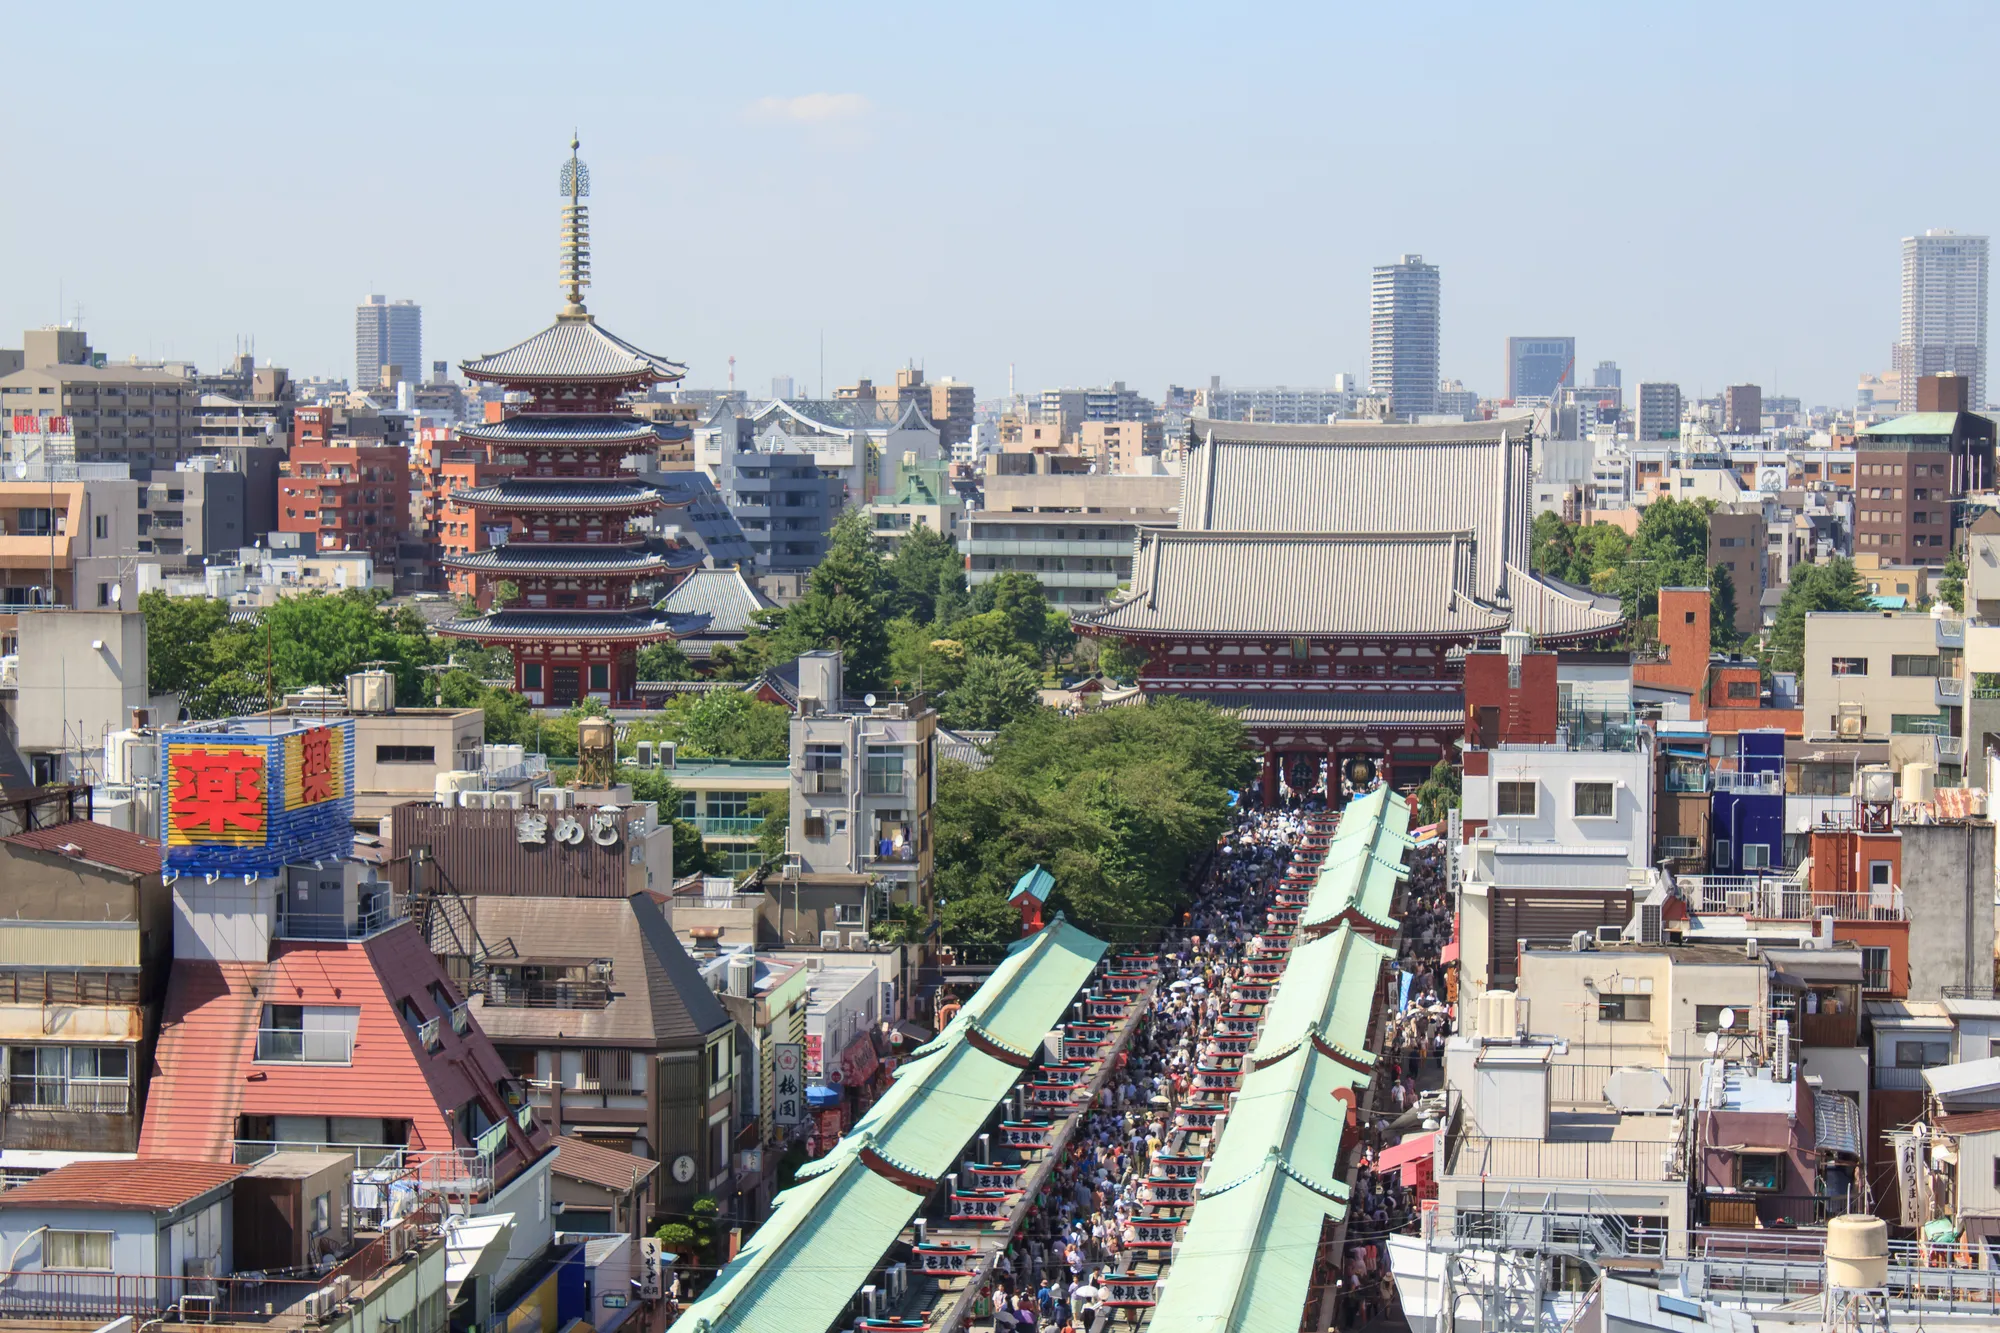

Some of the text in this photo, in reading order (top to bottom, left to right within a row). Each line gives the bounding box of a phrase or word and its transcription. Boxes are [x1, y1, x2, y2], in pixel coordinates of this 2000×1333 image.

[14, 415, 41, 433] HOTEL
[171, 750, 264, 833] 薬
[302, 726, 332, 803] 薬
[778, 1074, 798, 1117] 梅園
